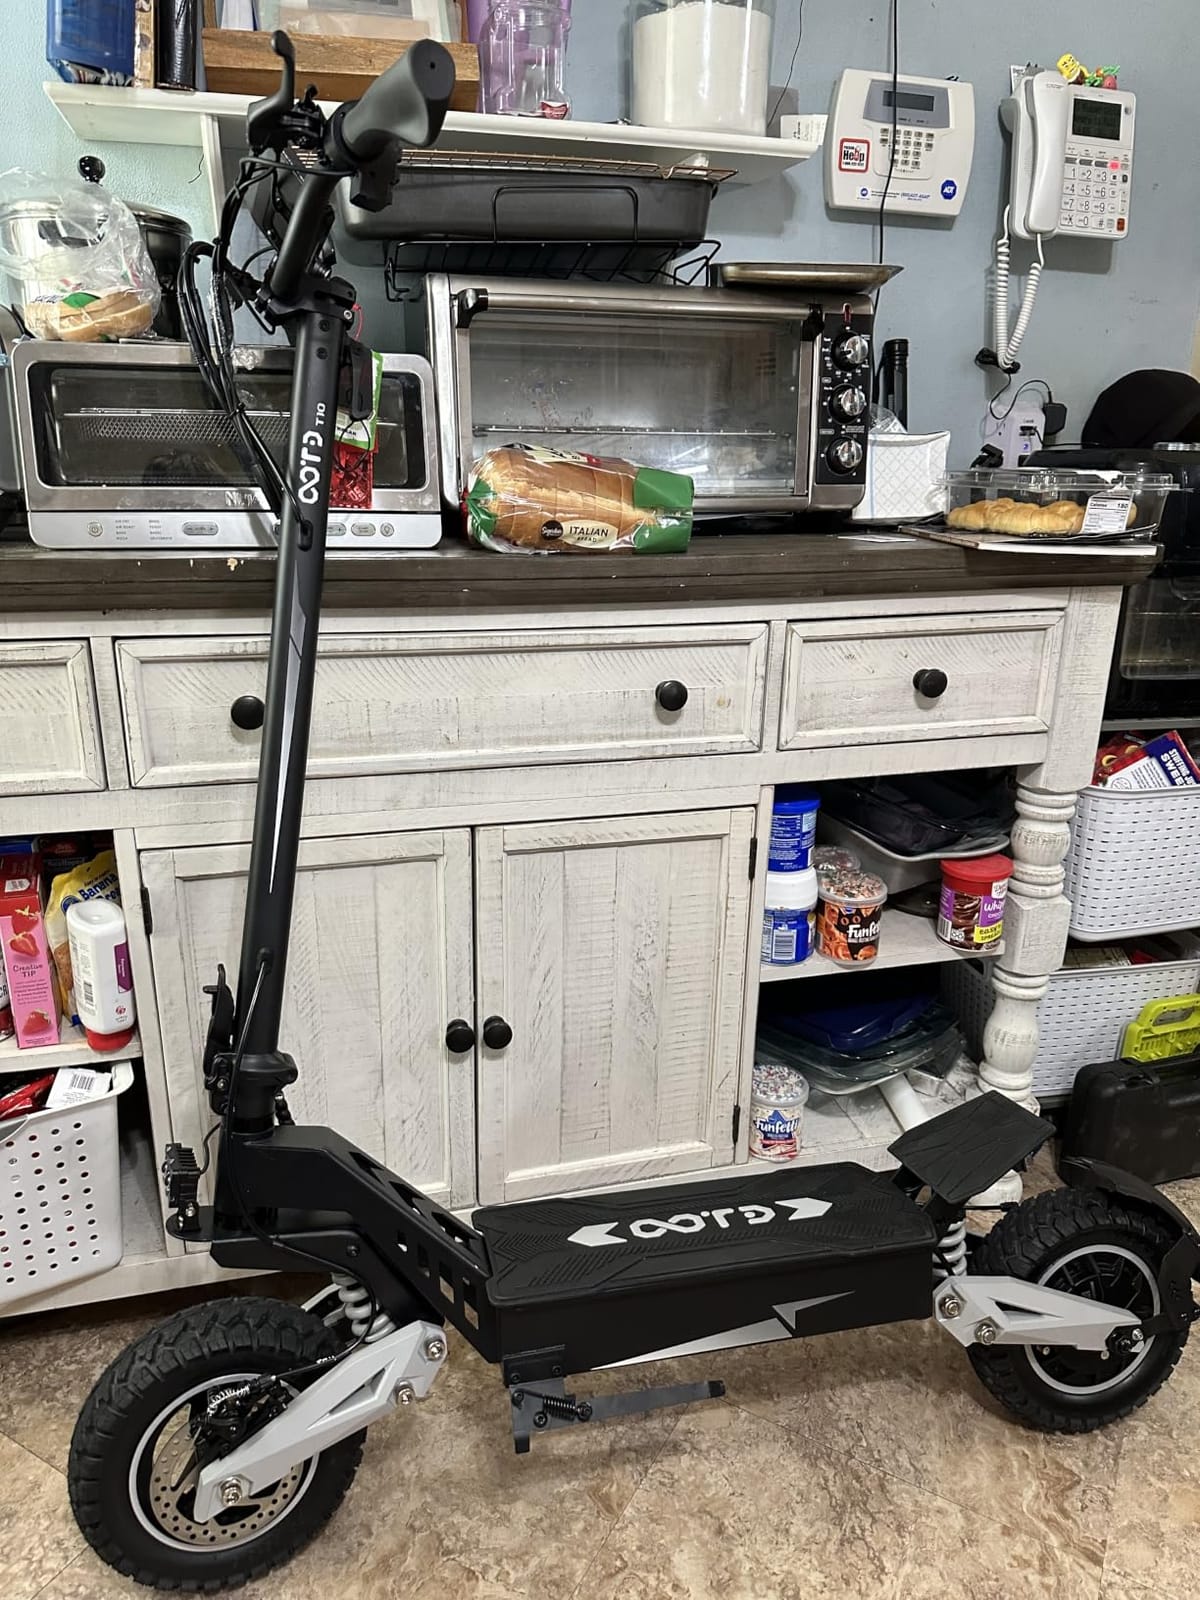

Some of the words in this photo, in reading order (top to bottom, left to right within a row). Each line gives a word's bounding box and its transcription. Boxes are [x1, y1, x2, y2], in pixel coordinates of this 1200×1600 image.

[569, 526, 609, 537] ITALIAN
[1160, 752, 1186, 786] SWEE
[78, 872, 118, 901] Banana
[12, 964, 44, 973] Creative
[22, 970, 37, 978] TIP
